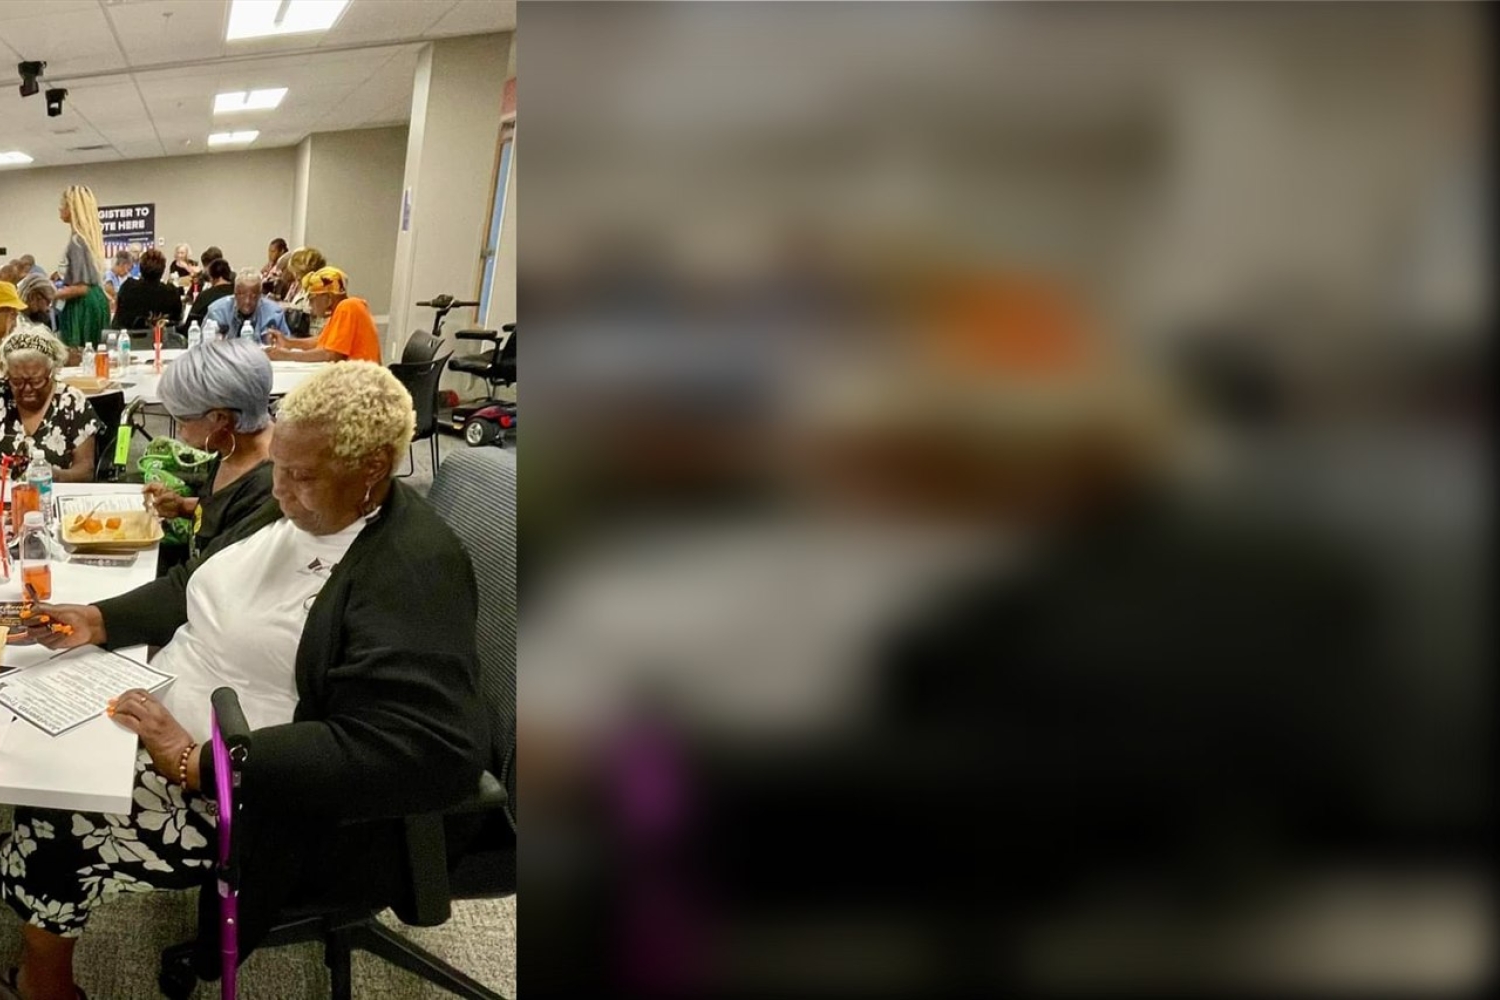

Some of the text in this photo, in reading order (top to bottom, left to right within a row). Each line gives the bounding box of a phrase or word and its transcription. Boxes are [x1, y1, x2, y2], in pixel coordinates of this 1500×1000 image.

[98, 207, 150, 219] GISTER TO
[100, 219, 145, 231] OTE HERE
